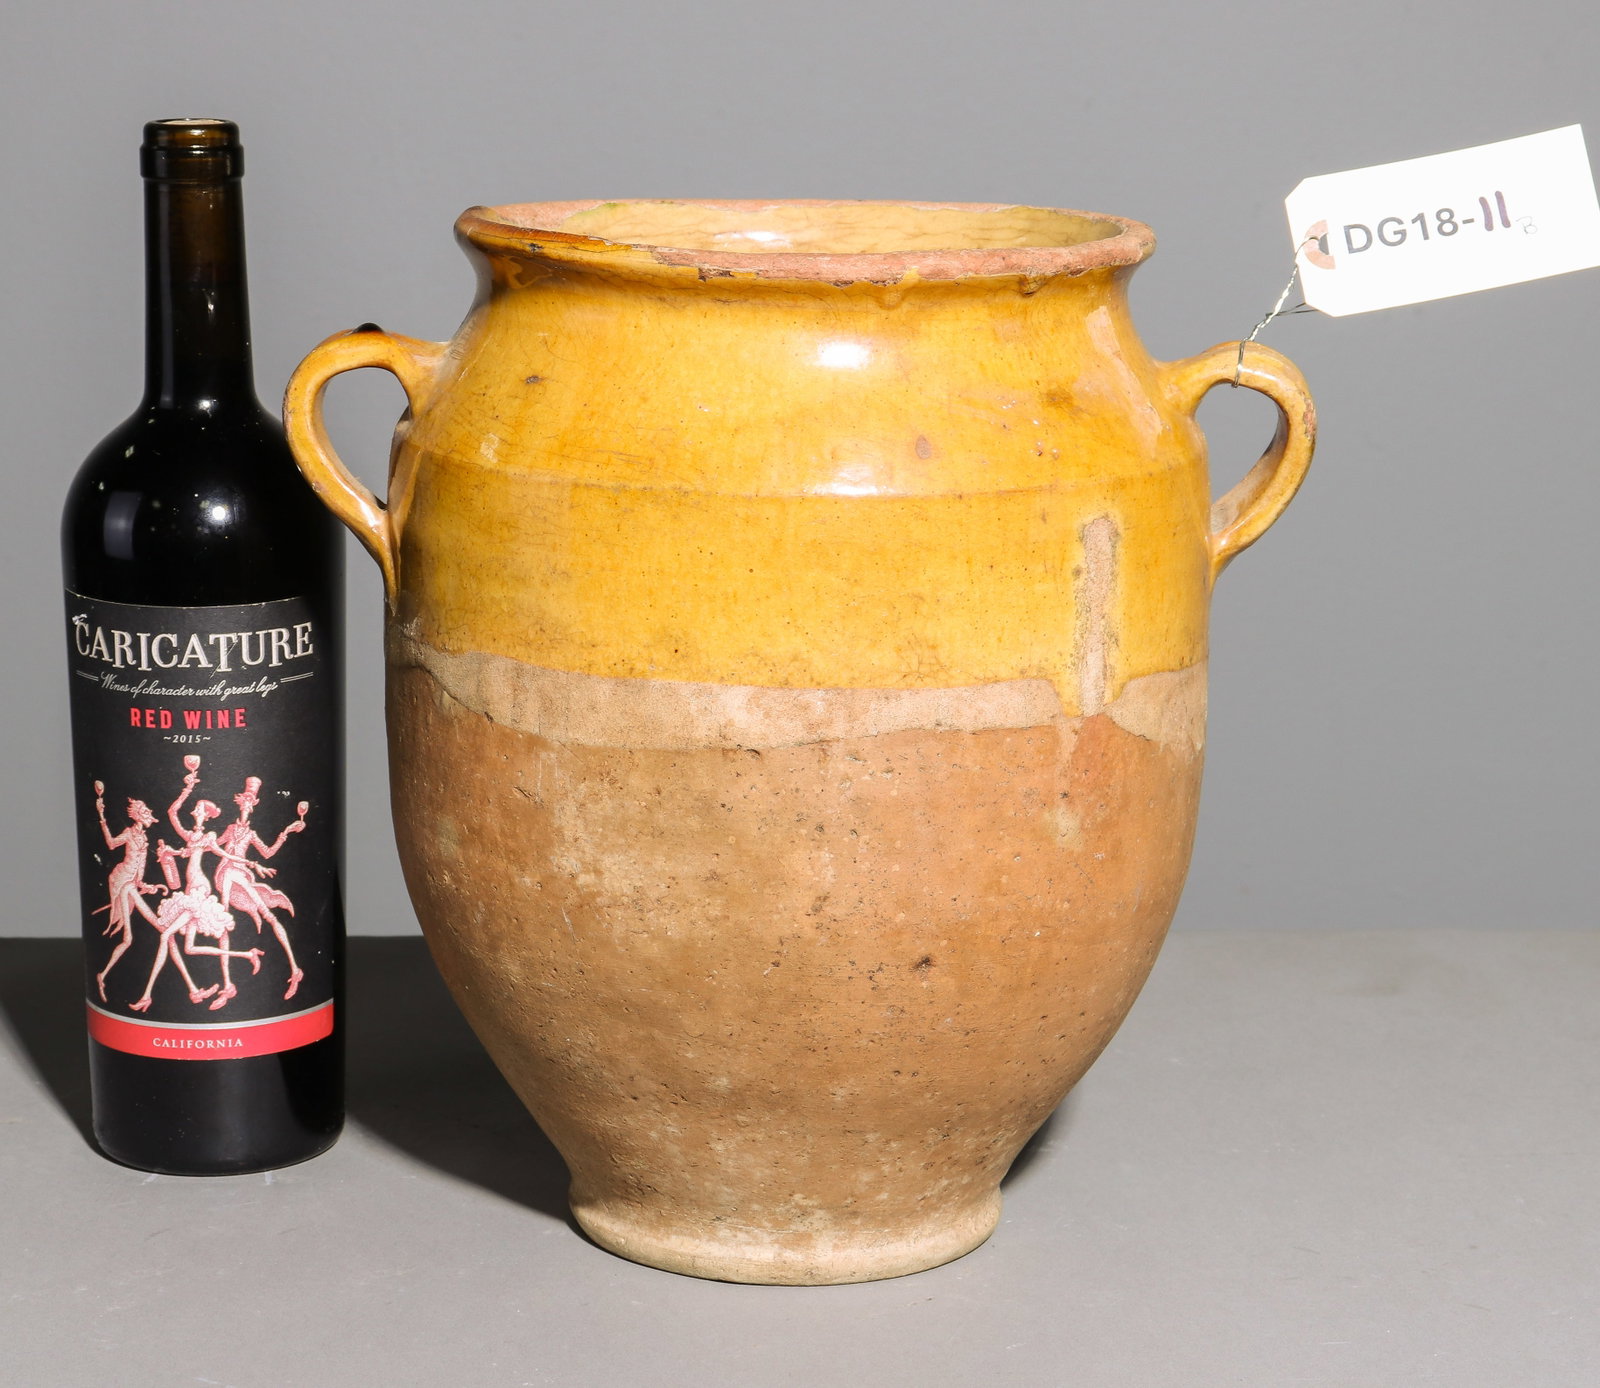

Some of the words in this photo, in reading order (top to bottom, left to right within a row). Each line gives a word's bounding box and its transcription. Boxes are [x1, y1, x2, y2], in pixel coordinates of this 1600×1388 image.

[75, 621, 314, 672] CARICATURE
[100, 671, 131, 693] Wines
[130, 679, 143, 699] of
[142, 679, 195, 697] character
[195, 679, 224, 697] with
[220, 681, 257, 701] great
[255, 675, 279, 698] legs
[130, 707, 173, 730] RED
[183, 708, 247, 730] WINE
[152, 1037, 244, 1049] CALIFORNIA
